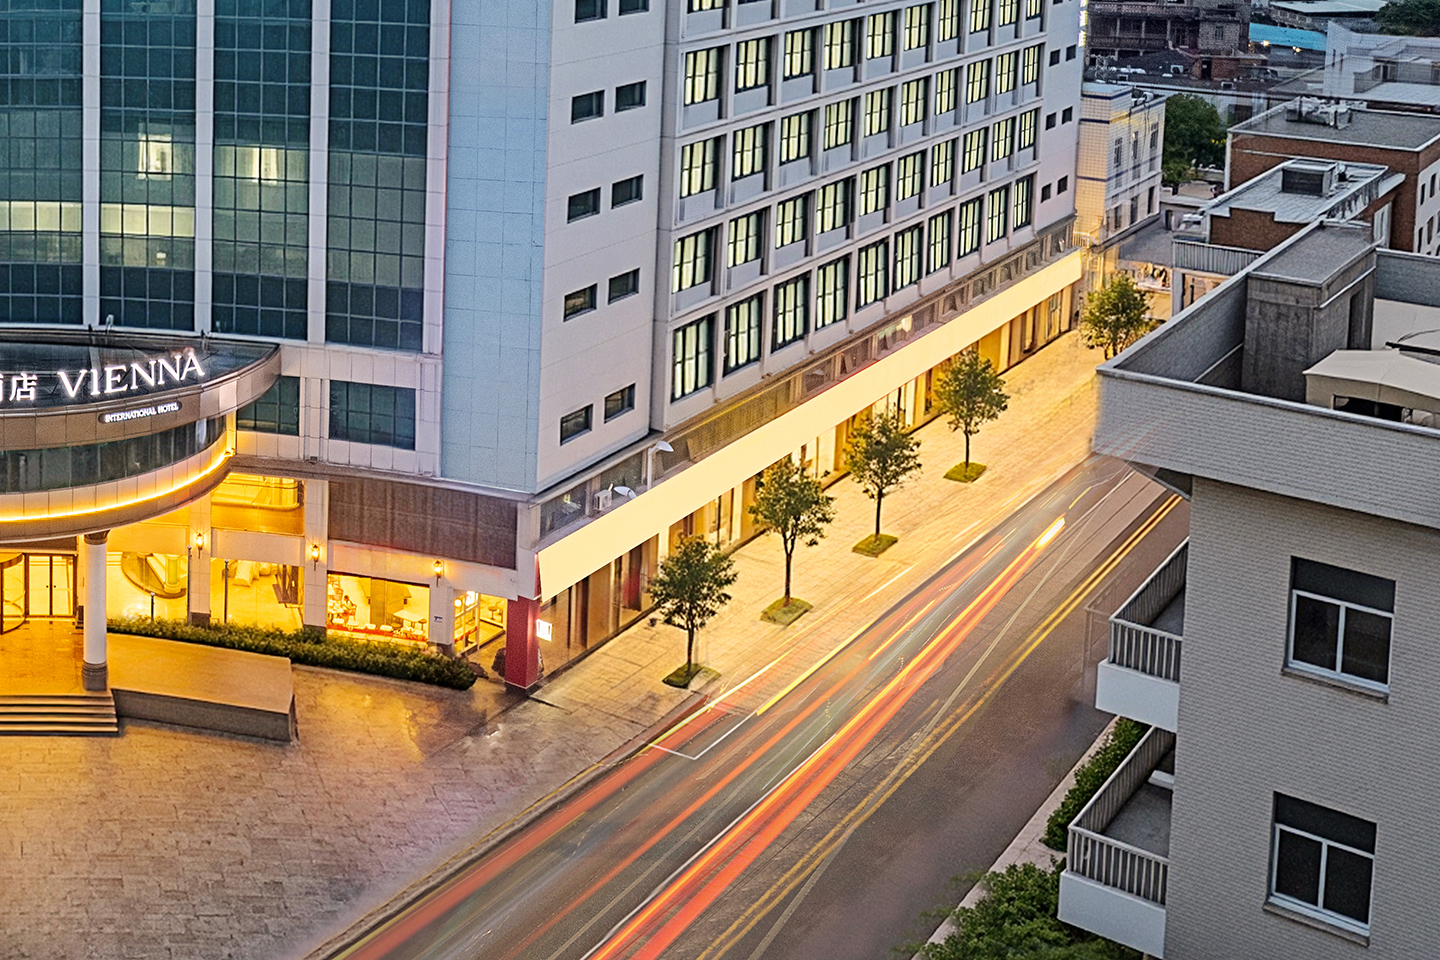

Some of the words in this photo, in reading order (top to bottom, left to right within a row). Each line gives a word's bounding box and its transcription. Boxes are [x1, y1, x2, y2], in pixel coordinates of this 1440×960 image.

[56, 351, 206, 398] VIENNA
[104, 406, 157, 423] INTERNATIONAL
[157, 401, 180, 415] HOTEL
